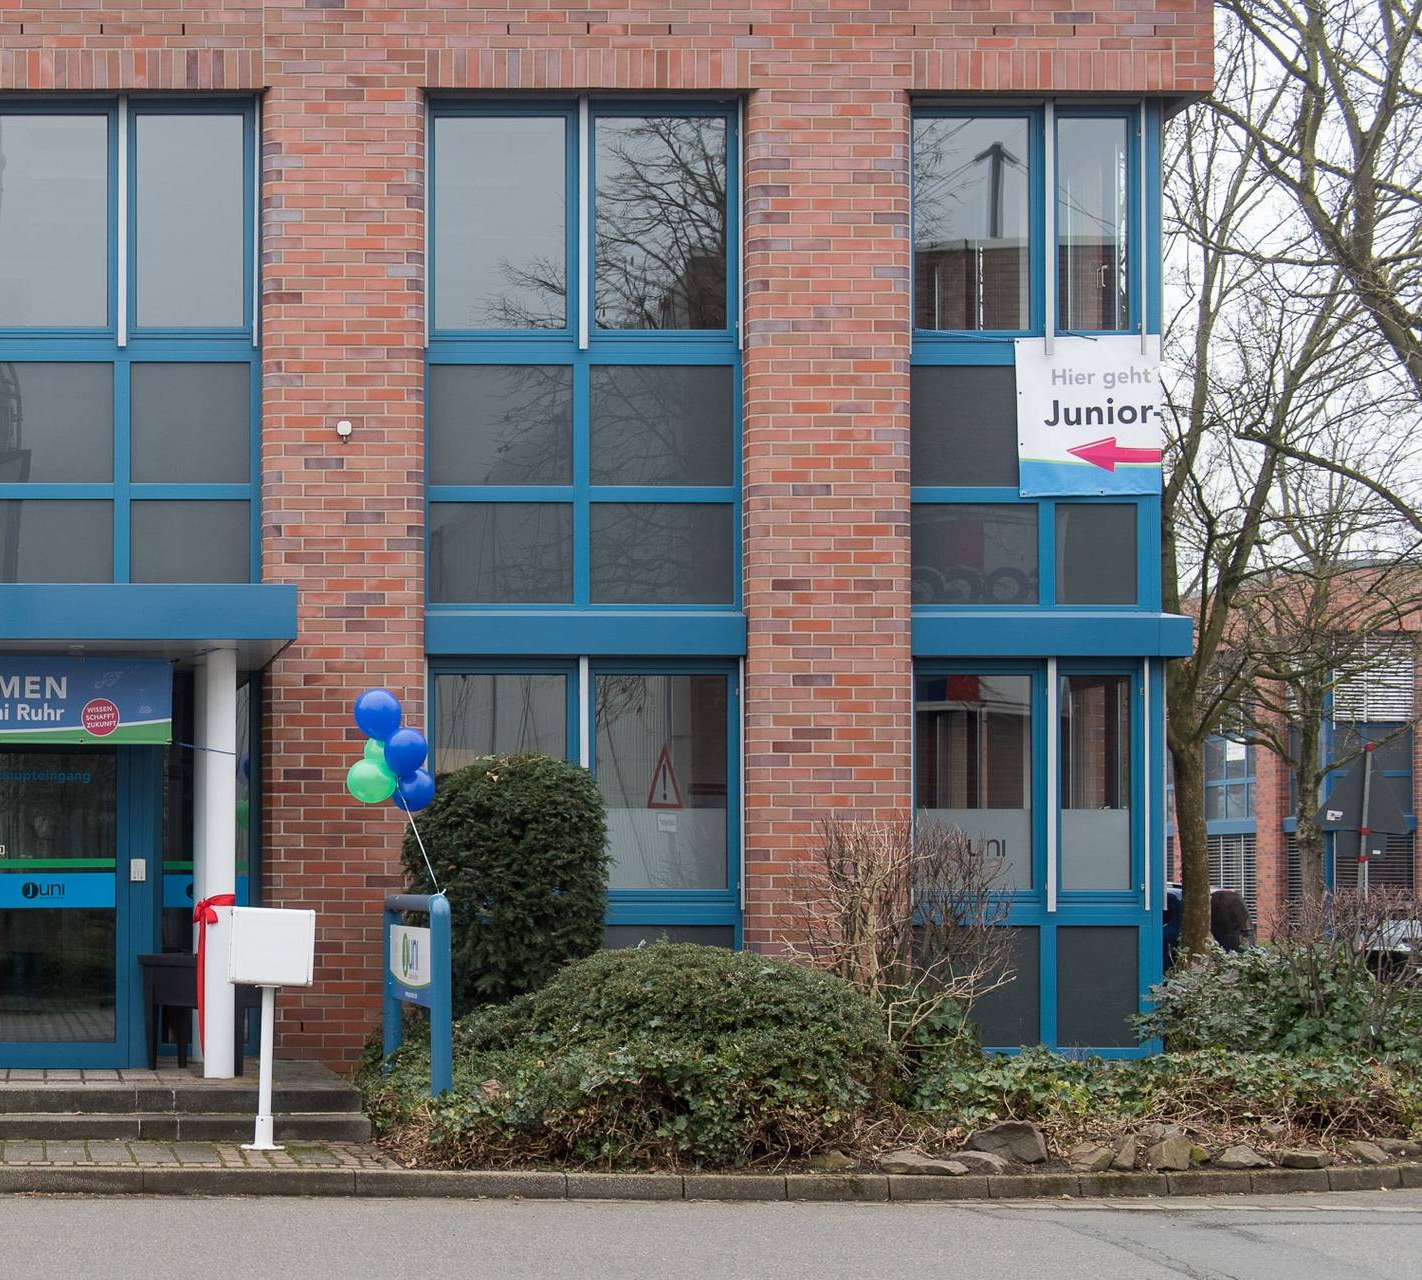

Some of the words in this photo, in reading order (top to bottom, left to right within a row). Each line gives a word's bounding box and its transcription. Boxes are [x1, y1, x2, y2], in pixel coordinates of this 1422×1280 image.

[1051, 368, 1095, 386] Hier
[1103, 366, 1151, 389] geht
[1044, 398, 1161, 427] Junior-
[16, 703, 65, 721] Ruhr
[87, 705, 113, 713] WISSEN
[85, 713, 115, 721] SCHAFFT
[86, 720, 117, 729] ZUKUNFT
